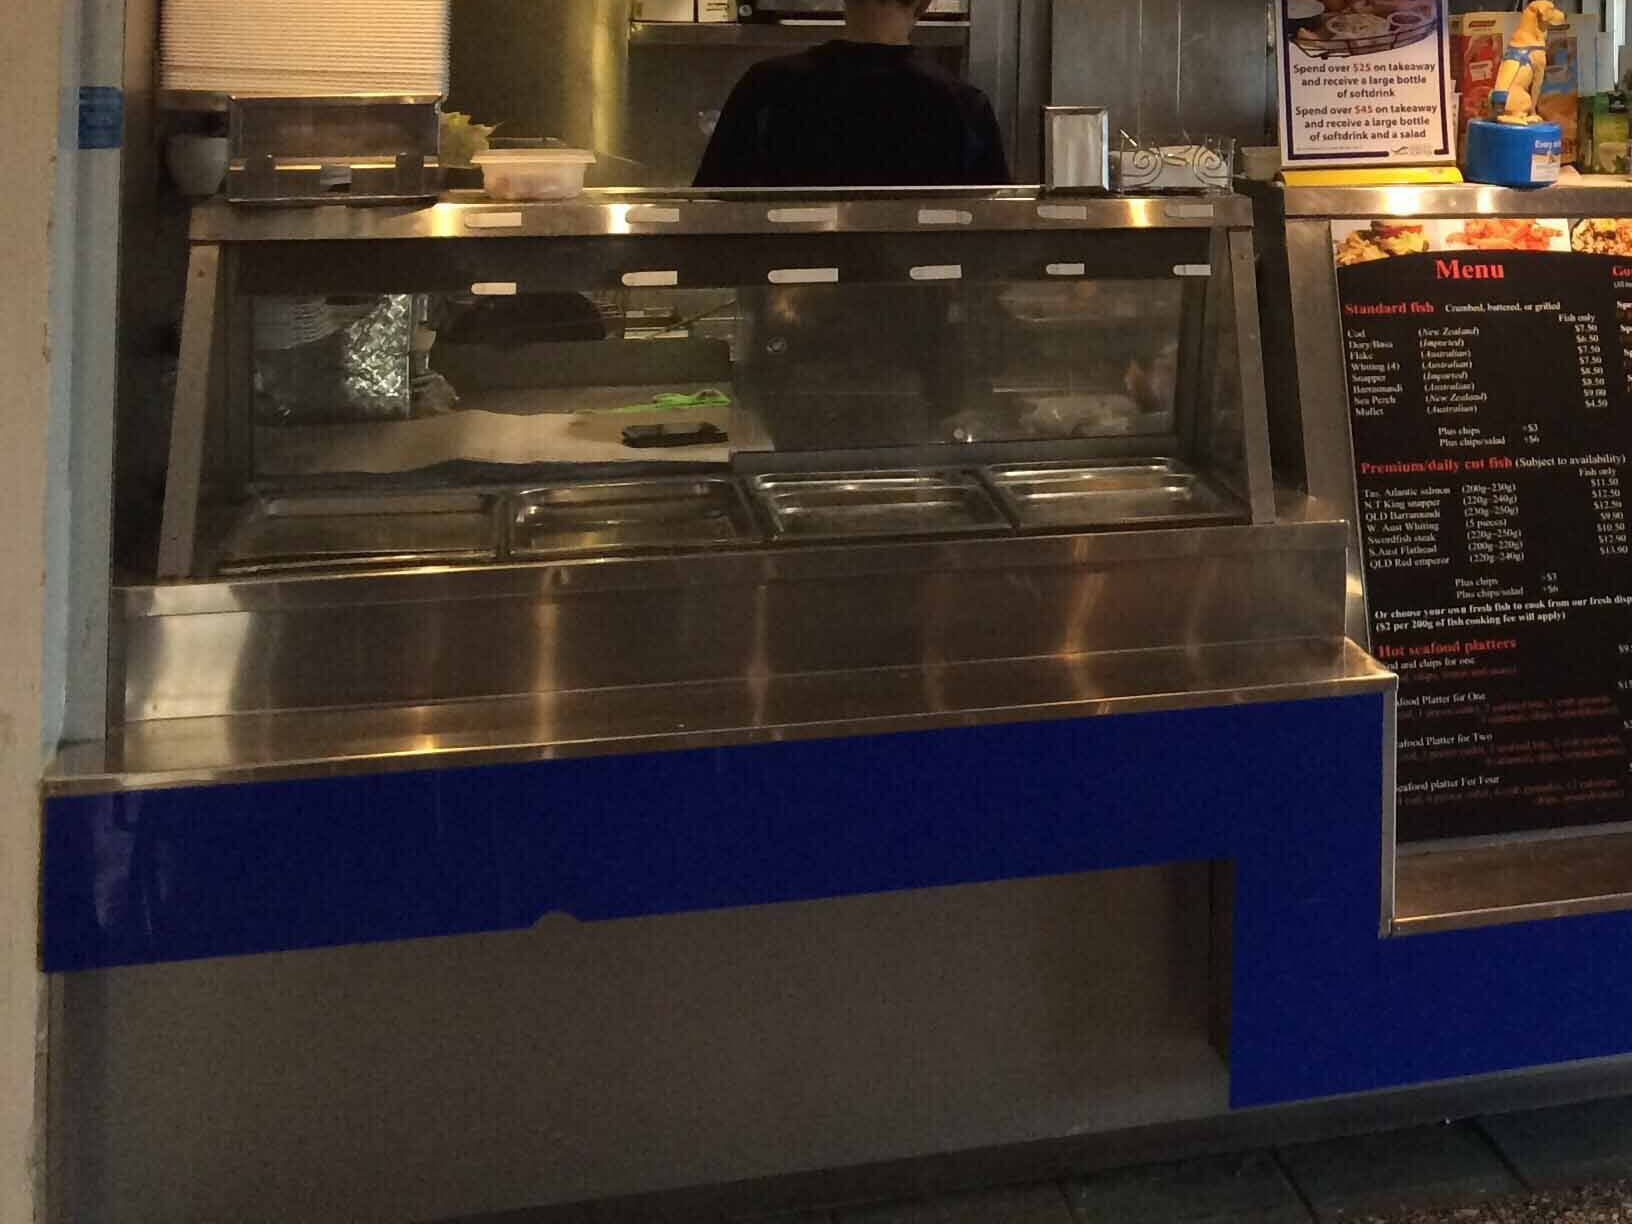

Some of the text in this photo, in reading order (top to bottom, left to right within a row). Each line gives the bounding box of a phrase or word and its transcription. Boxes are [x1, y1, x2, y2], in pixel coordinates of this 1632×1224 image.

[1293, 63, 1326, 74] Spend
[1352, 63, 1372, 73] $25
[1388, 63, 1436, 74] takeaway
[1302, 76, 1321, 86] and
[1324, 76, 1359, 86] receive
[1369, 75, 1394, 87] large
[1397, 75, 1426, 85] bottle
[1337, 88, 1395, 98] of softdrink
[1296, 106, 1328, 117] Spend
[1330, 107, 1352, 115] over
[1354, 105, 1374, 114] $45
[1390, 105, 1438, 115] takeaway
[1304, 118, 1324, 128] and
[1326, 118, 1362, 127] receive
[1372, 117, 1398, 129] large
[1400, 116, 1430, 126] bottle
[1309, 131, 1320, 141] of
[1322, 130, 1368, 141] softdrink
[1370, 130, 1390, 139] and
[1400, 129, 1426, 139] salad
[1435, 259, 1504, 279] Menu
[1344, 303, 1407, 314] Standard
[1410, 301, 1434, 313] fish
[1445, 303, 1486, 314] Crumbed,
[1558, 313, 1576, 323] Fish
[1465, 459, 1485, 471] cut
[1488, 457, 1513, 470] fish
[1515, 457, 1555, 469] (Subject
[1557, 456, 1567, 466] to
[1569, 454, 1626, 466] availability)
[1374, 609, 1389, 620] Or
[1390, 608, 1422, 619] choose
[1447, 606, 1467, 616] own
[1469, 603, 1493, 614] fresh
[1494, 602, 1513, 613] fish
[1514, 601, 1524, 611] to
[1525, 599, 1547, 610] cook
[1548, 597, 1570, 608] from
[1571, 598, 1588, 608] our
[1590, 595, 1613, 606] fresh
[1393, 622, 1410, 634] per
[1435, 618, 1446, 628] of
[1447, 616, 1465, 627] fish
[1465, 615, 1501, 628] cooking
[1503, 613, 1517, 624] fee
[1518, 611, 1536, 621] will
[1537, 610, 1567, 623] apply)
[1379, 643, 1404, 657] Hot
[1408, 641, 1460, 656] seafood
[1464, 638, 1518, 653] platters
[1400, 660, 1417, 670] and
[1419, 657, 1442, 669] chips
[1444, 656, 1457, 667] for
[1422, 693, 1450, 705] Platter
[1452, 692, 1466, 703] for
[1457, 733, 1471, 744] for
